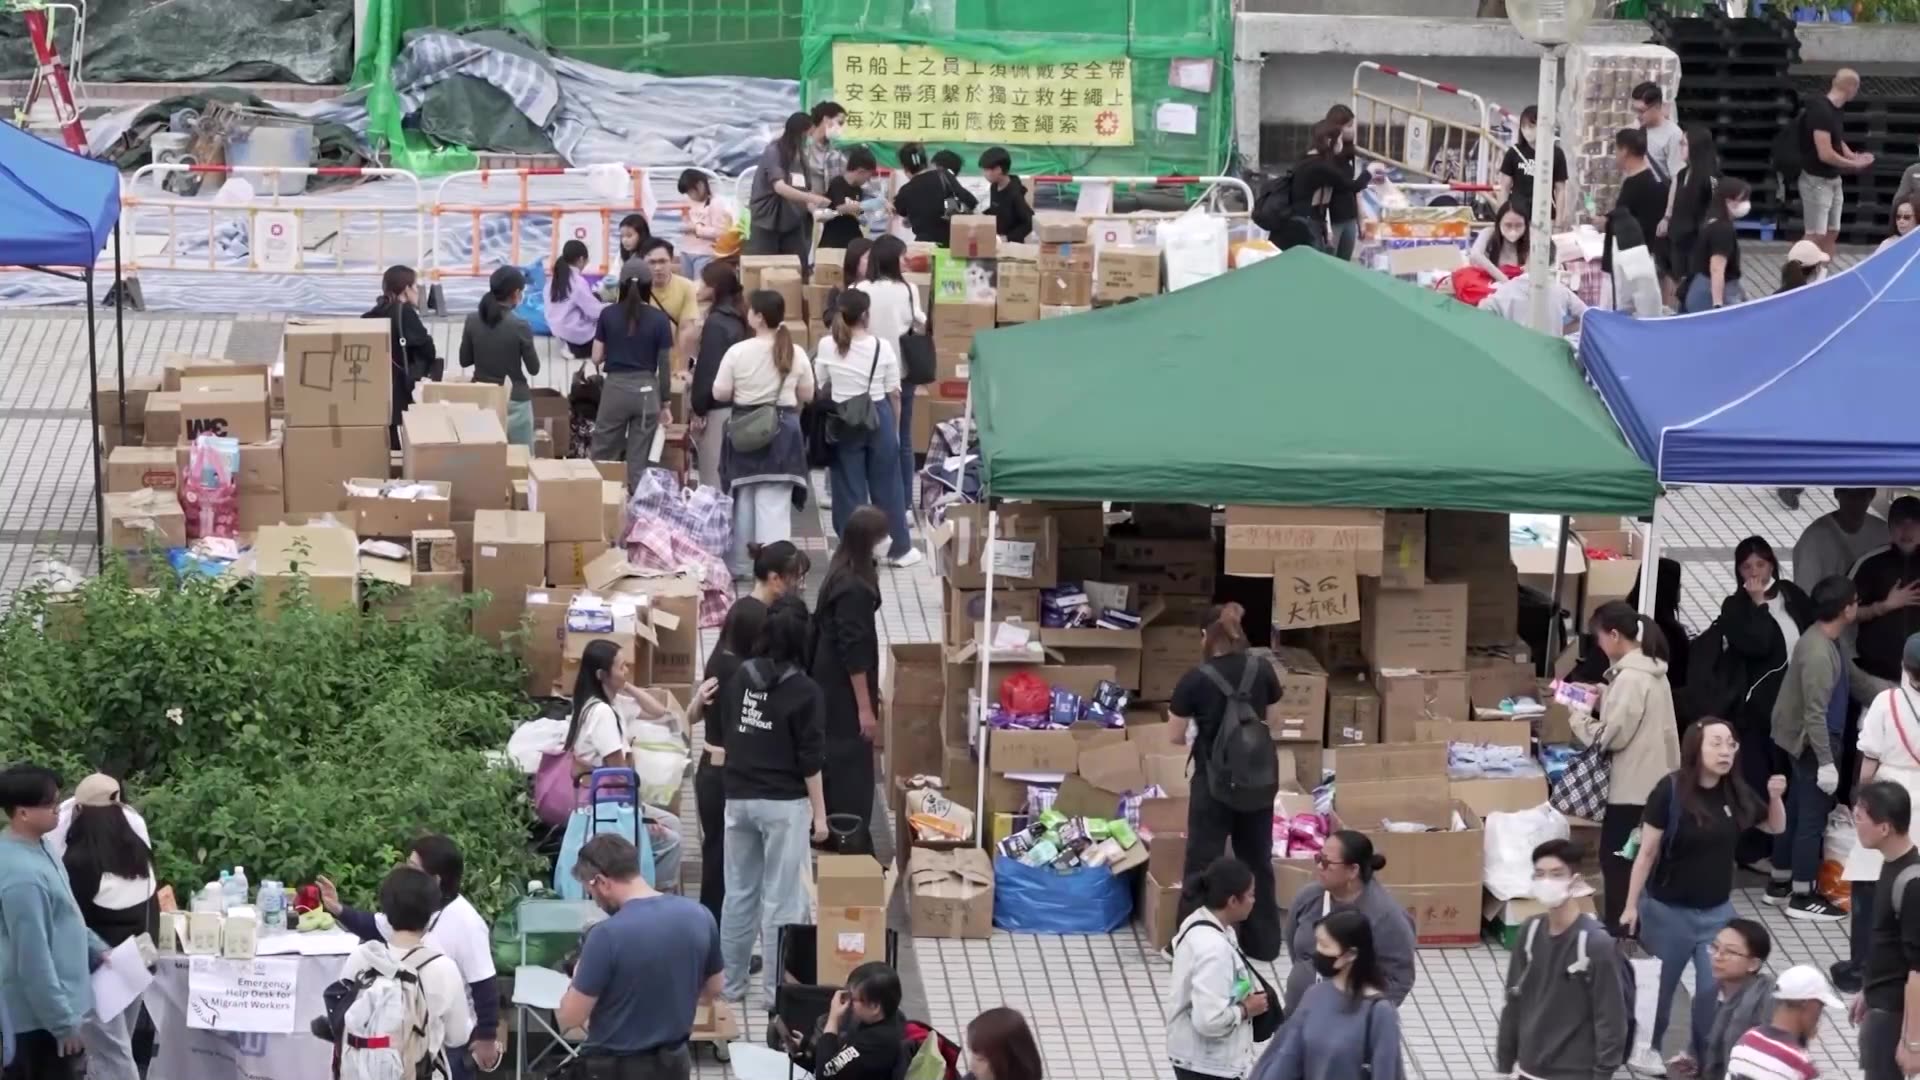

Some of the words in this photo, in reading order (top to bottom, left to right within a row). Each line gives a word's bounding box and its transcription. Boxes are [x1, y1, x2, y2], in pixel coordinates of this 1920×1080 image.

[846, 110, 1079, 134] 每次開工前應檢查繩索
[741, 716, 772, 730] without
[238, 977, 291, 990] Emergency
[226, 988, 249, 998] Help
[251, 989, 274, 998] Desk
[276, 989, 291, 999] for
[210, 997, 248, 1010] Migrant
[250, 1000, 291, 1010] Workers
